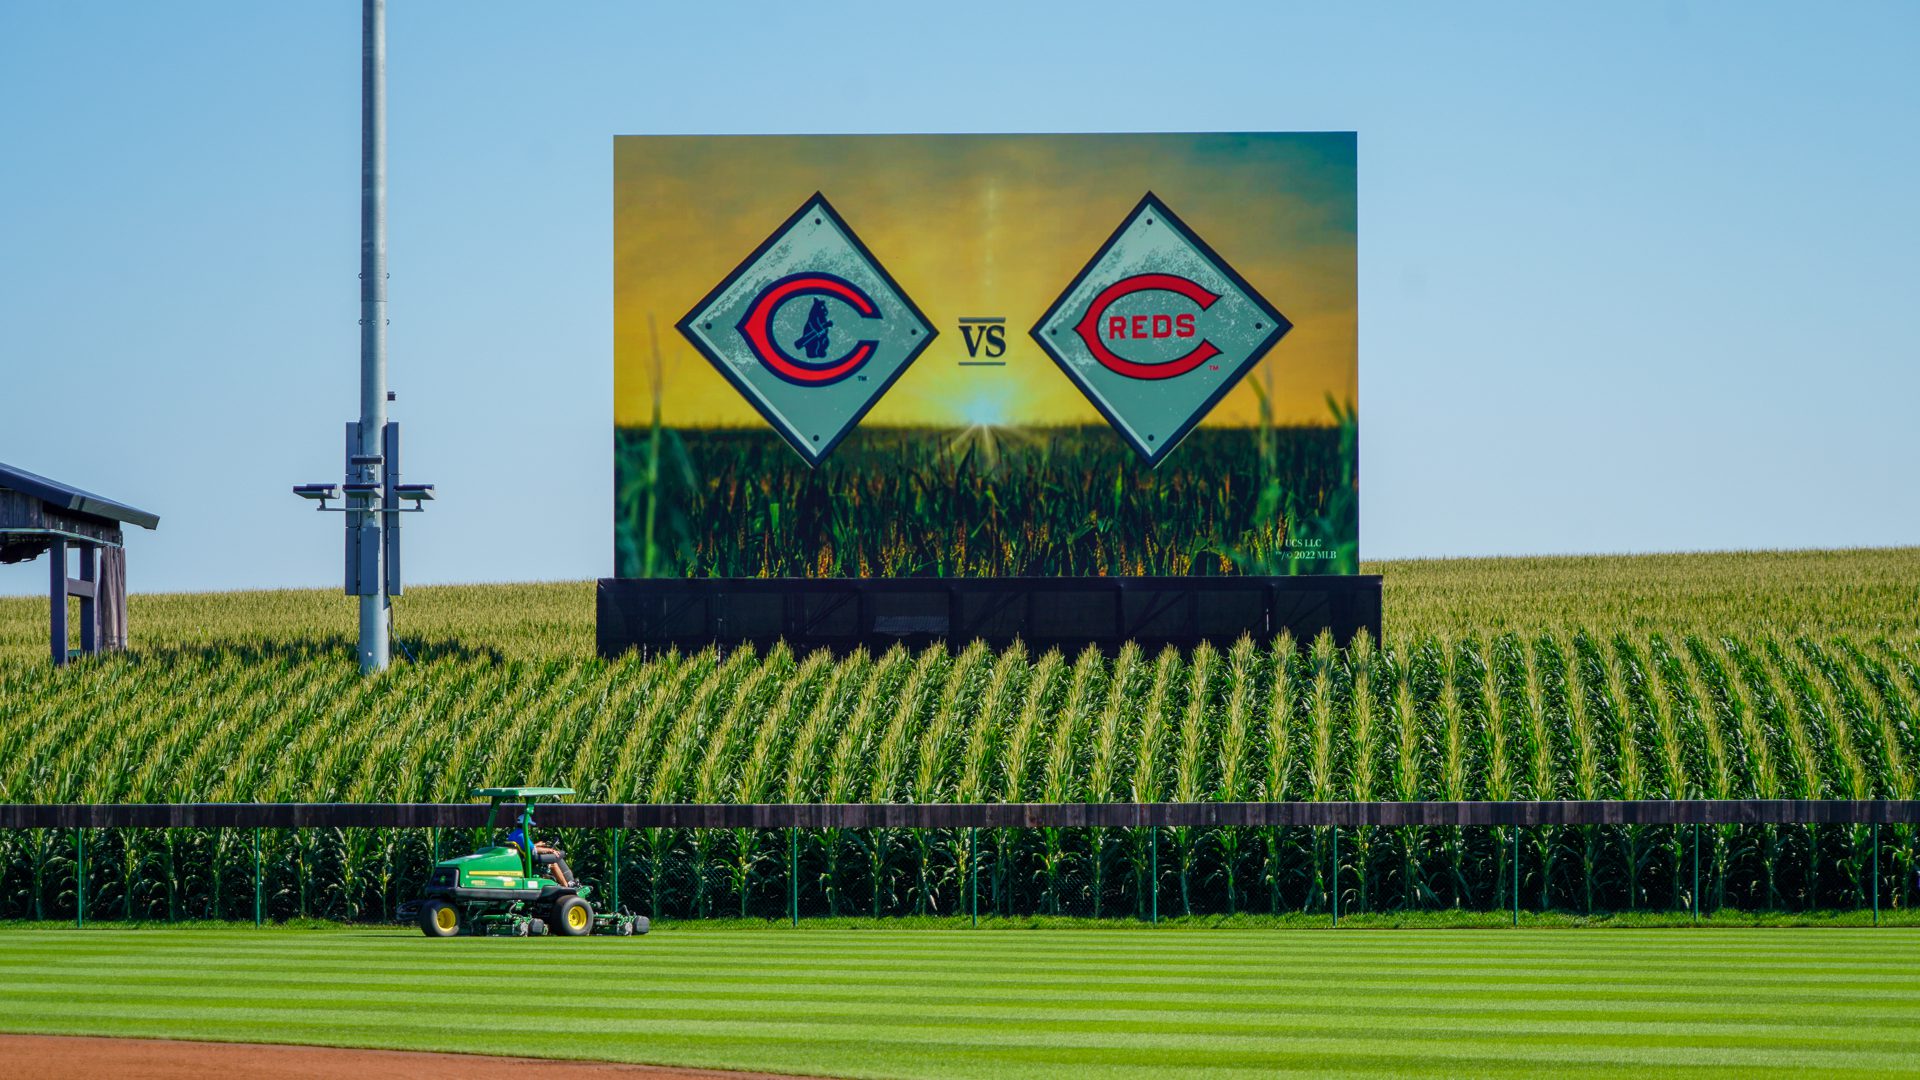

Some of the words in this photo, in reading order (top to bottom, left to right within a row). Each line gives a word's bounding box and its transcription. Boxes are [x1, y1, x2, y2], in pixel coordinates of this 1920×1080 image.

[1108, 313, 1196, 340] REDS
[958, 325, 1006, 358] VS
[1285, 538, 1303, 548] UCS
[1304, 538, 1322, 548] LLC
[1294, 550, 1315, 560] 2022
[1316, 550, 1337, 560] MLB
